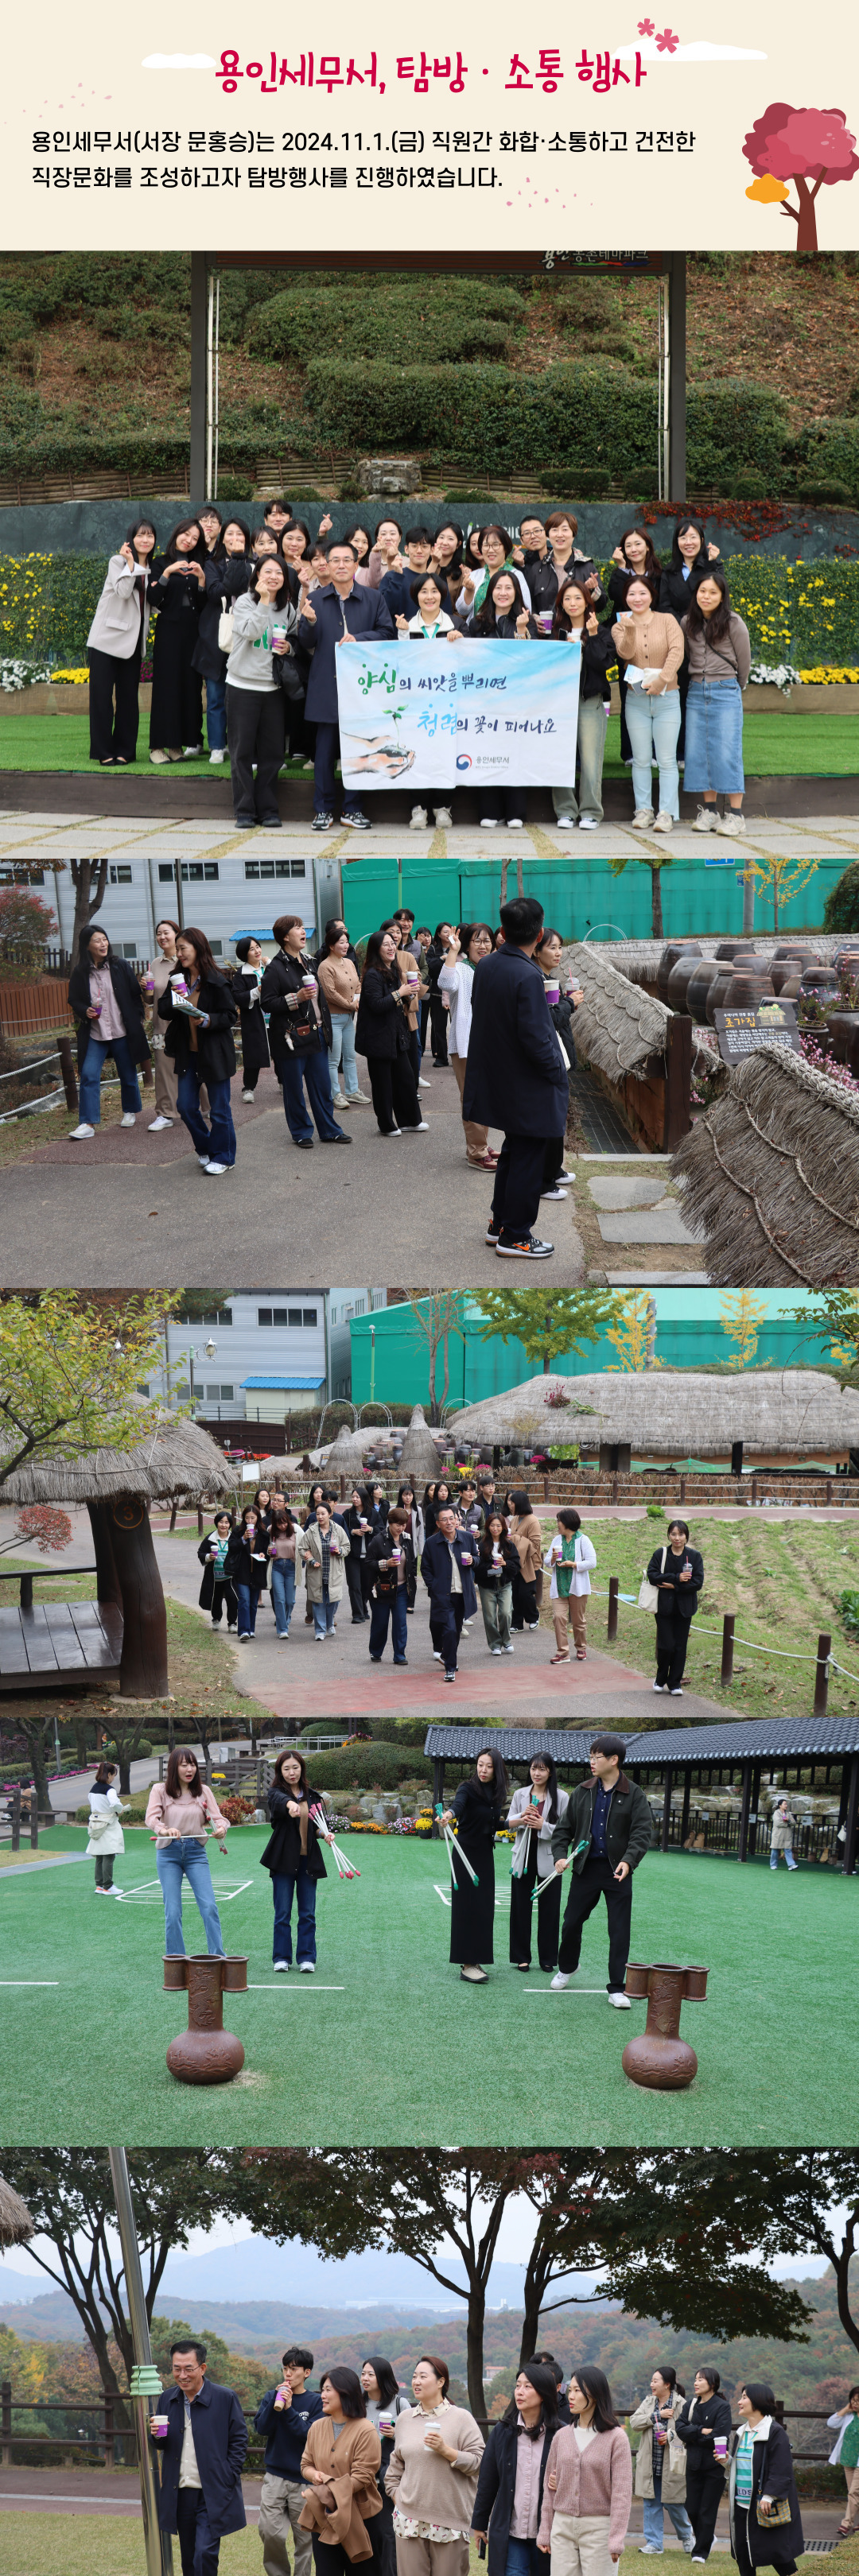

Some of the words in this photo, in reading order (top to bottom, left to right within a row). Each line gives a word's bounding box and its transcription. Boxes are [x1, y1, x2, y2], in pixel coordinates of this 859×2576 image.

[358, 663, 412, 695] 양심의
[418, 673, 457, 692] 씨앗을
[461, 673, 507, 690] 뿌리면
[417, 703, 468, 737] 청렴의
[474, 715, 499, 735] 꽃이
[505, 718, 558, 735] 피어나요
[725, 1017, 756, 1027] 초가집
[123, 1506, 134, 1521] 3
